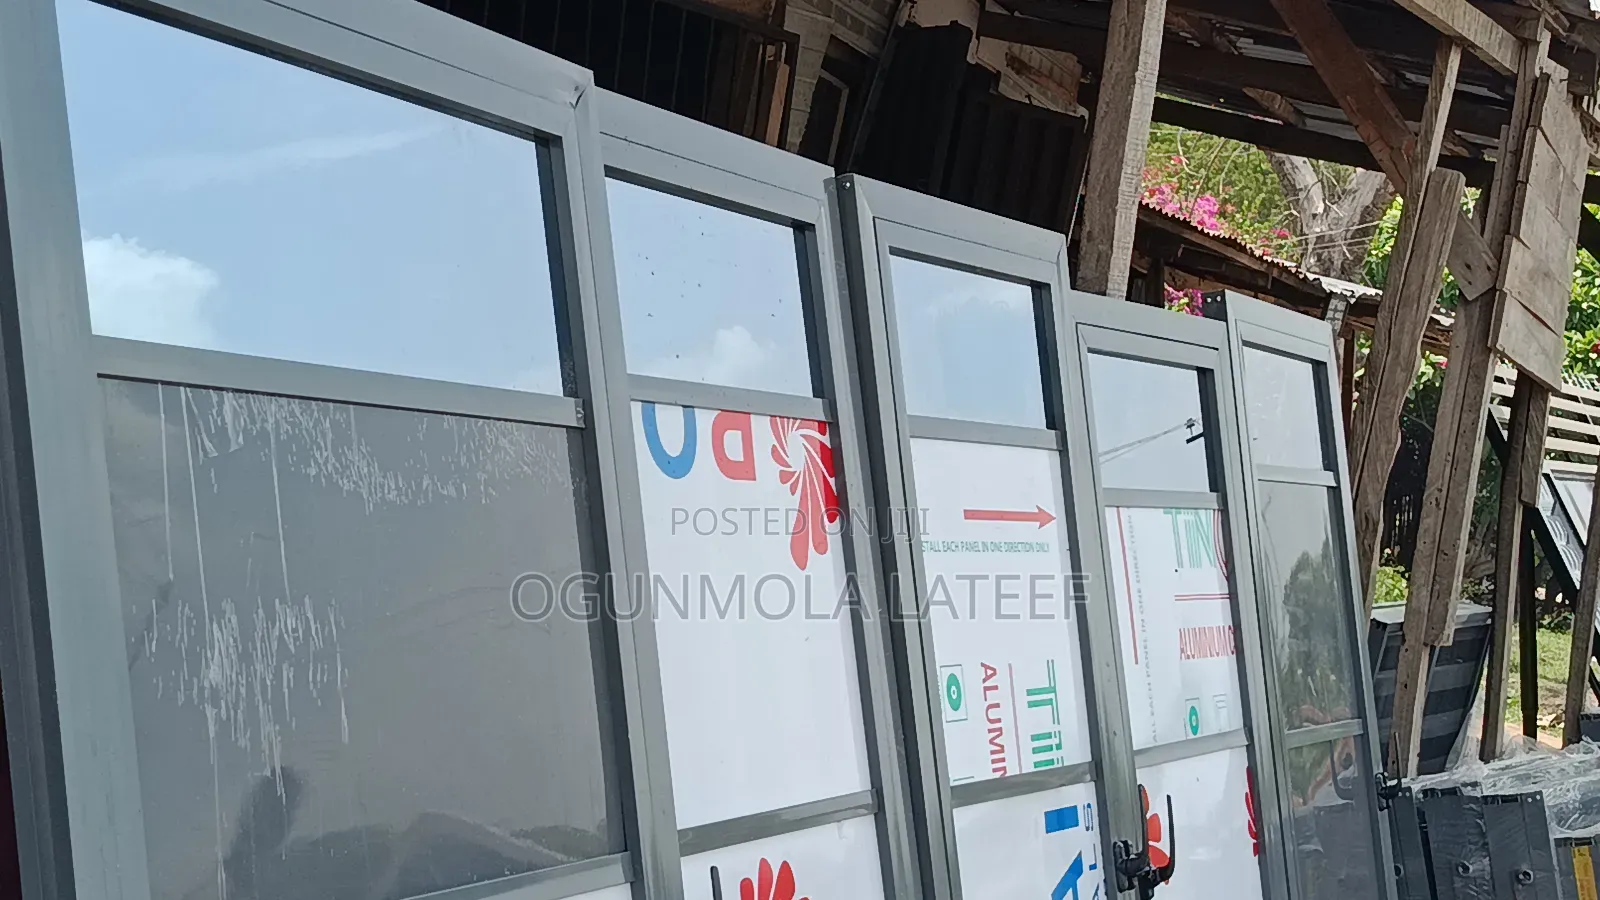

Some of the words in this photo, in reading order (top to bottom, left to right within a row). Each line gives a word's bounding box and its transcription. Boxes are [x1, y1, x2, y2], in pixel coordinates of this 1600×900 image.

[942, 540, 959, 553] EACH
[960, 540, 981, 553] PANEL
[982, 541, 989, 553] IN
[990, 541, 1003, 553] ONE
[1003, 541, 1035, 553] DIRECTION
